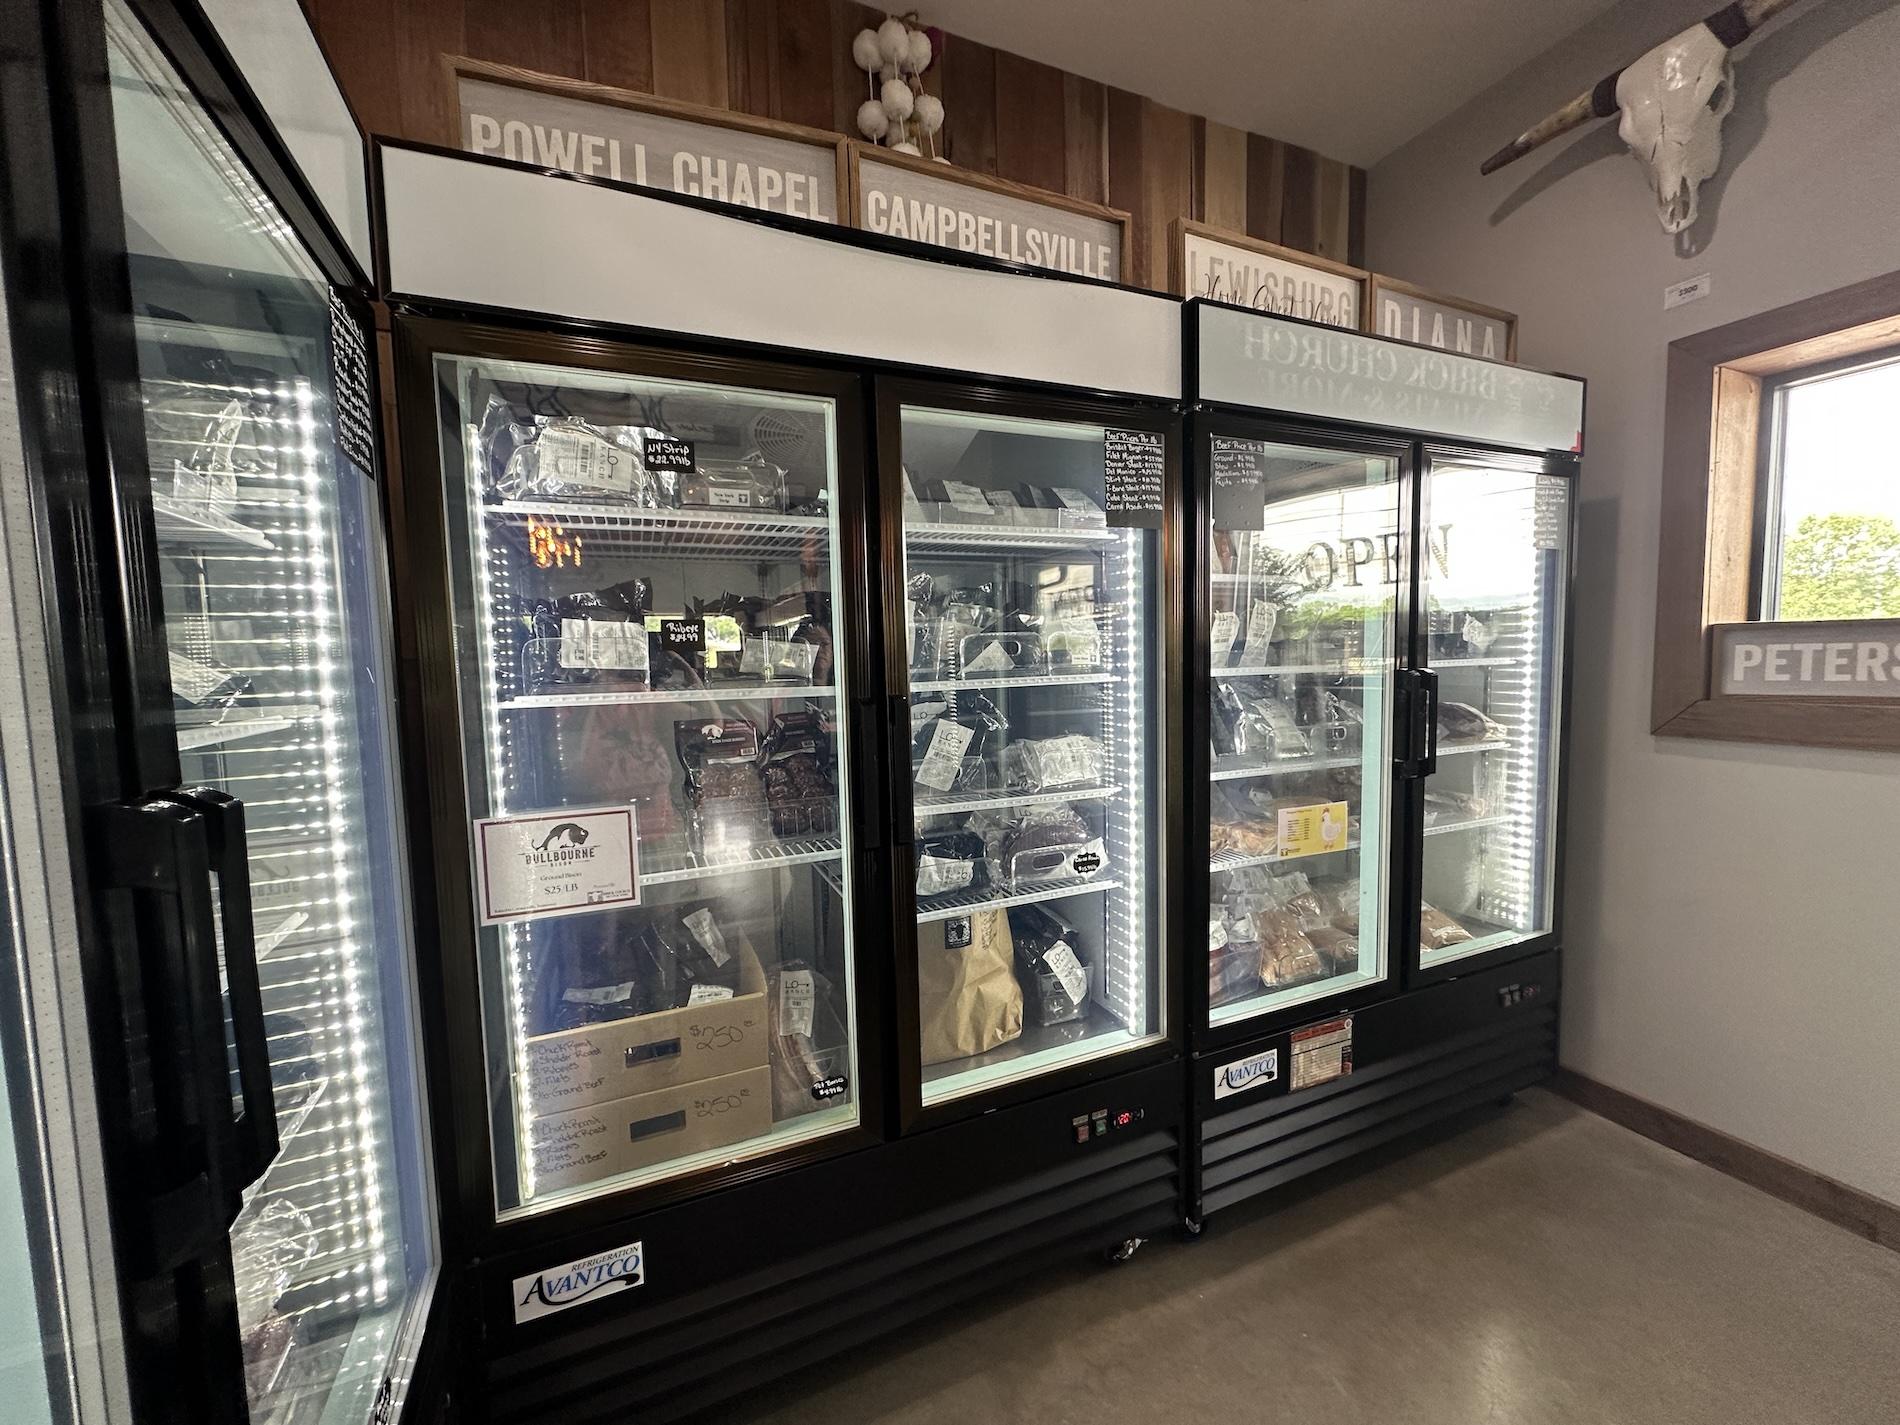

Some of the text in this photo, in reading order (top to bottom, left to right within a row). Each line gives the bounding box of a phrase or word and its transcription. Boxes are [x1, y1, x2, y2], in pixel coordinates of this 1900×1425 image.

[470, 113, 830, 222] POWELL CHAPEL
[867, 190, 1111, 280] CAMPBELLSVILLE
[1190, 250, 1351, 327] LEWISBURG
[1384, 299, 1495, 358] DIANA
[648, 442, 690, 454] NY Strip
[1215, 440, 1231, 449] Beef
[666, 621, 699, 633] Ribeye
[1733, 641, 1900, 682] PETER
[525, 847, 595, 865] BULLBOURNE
[540, 872, 565, 881] Ground
[690, 1025, 743, 1050] $250
[1217, 1057, 1276, 1089] AVANTCO
[571, 1245, 640, 1272] REFRIGERATION
[519, 1254, 641, 1307] AVANTCO
